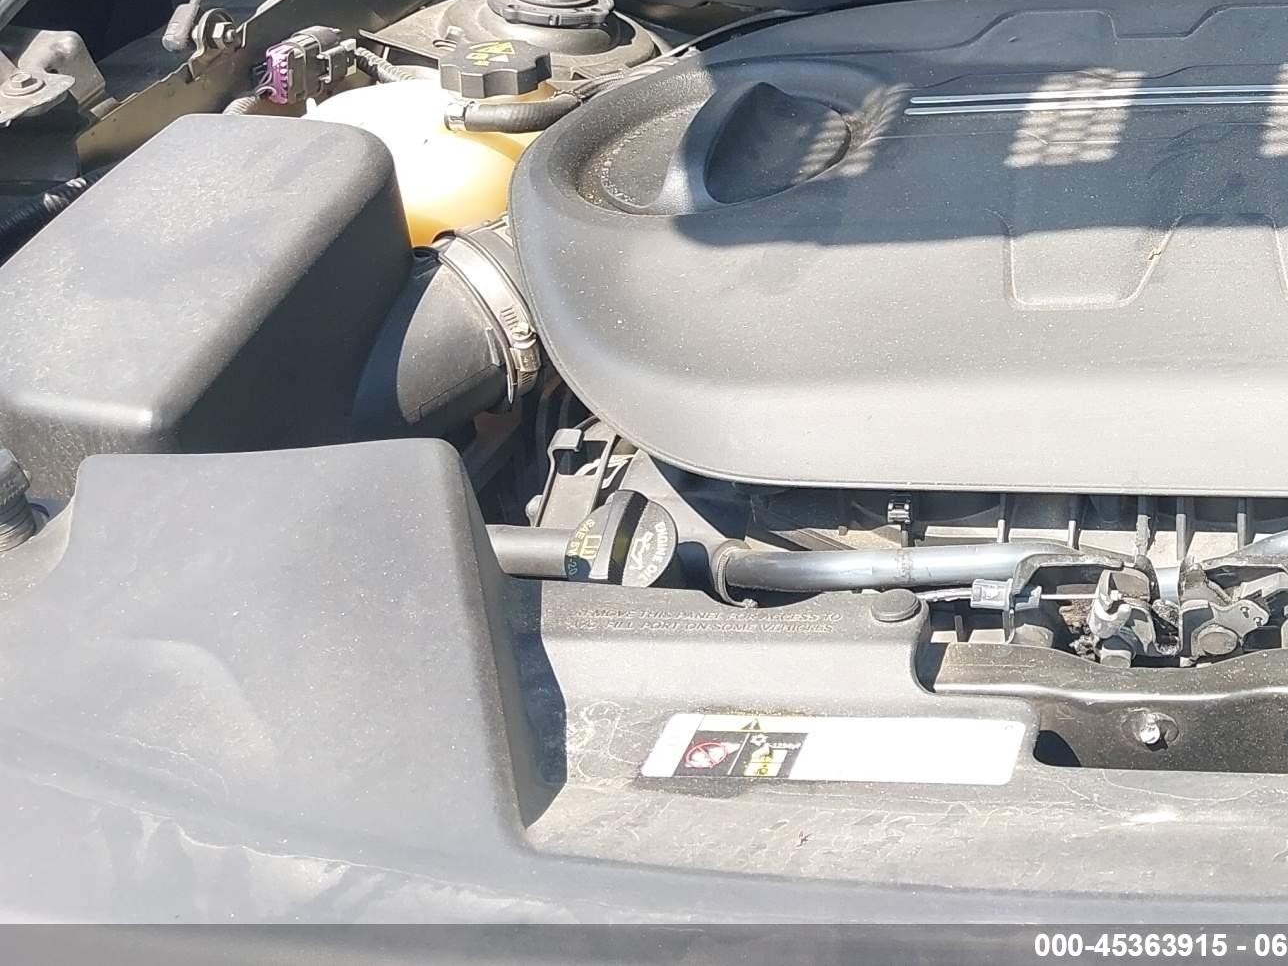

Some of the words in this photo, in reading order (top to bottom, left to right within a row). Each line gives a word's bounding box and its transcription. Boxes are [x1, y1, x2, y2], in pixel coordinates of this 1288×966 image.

[575, 519, 596, 540] SAE
[654, 521, 668, 563] ENGINE
[638, 564, 658, 582] OIL
[639, 610, 672, 620] THIS
[822, 613, 843, 622] TO
[685, 622, 712, 631] ON
